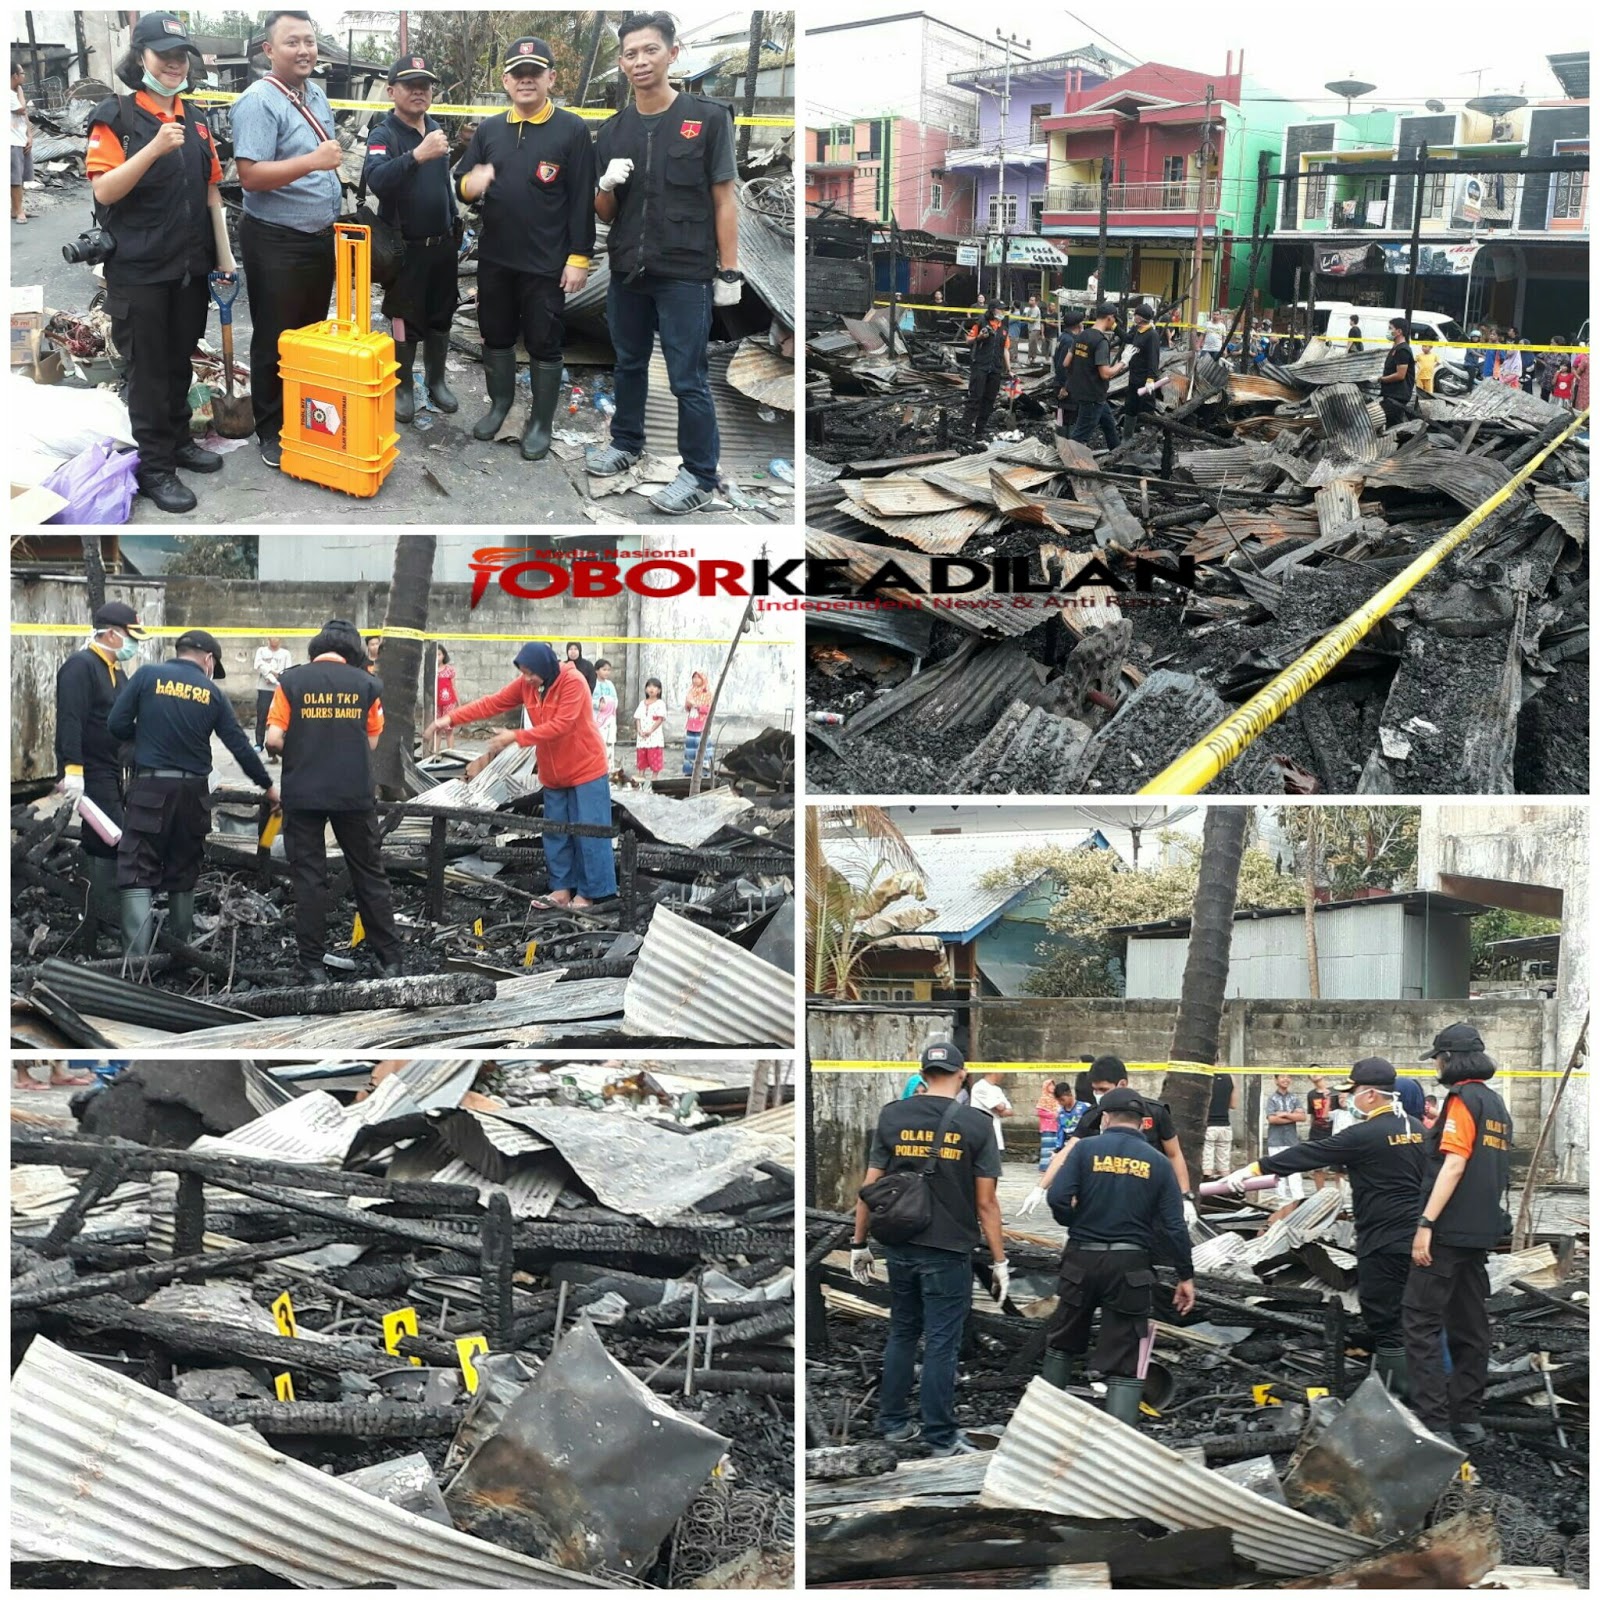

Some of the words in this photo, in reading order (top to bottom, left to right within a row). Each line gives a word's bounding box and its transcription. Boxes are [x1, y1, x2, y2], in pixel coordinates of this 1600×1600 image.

[156, 679, 211, 699] LABFOR
[303, 692, 333, 704] OLAH
[336, 692, 359, 704] TKP
[301, 707, 333, 719] POLRES
[334, 707, 363, 719] BARUT
[900, 1129, 935, 1142] OLAH
[942, 1132, 962, 1145] KP
[894, 1144, 933, 1158] POLRES
[1093, 1155, 1151, 1171] LABFOR
